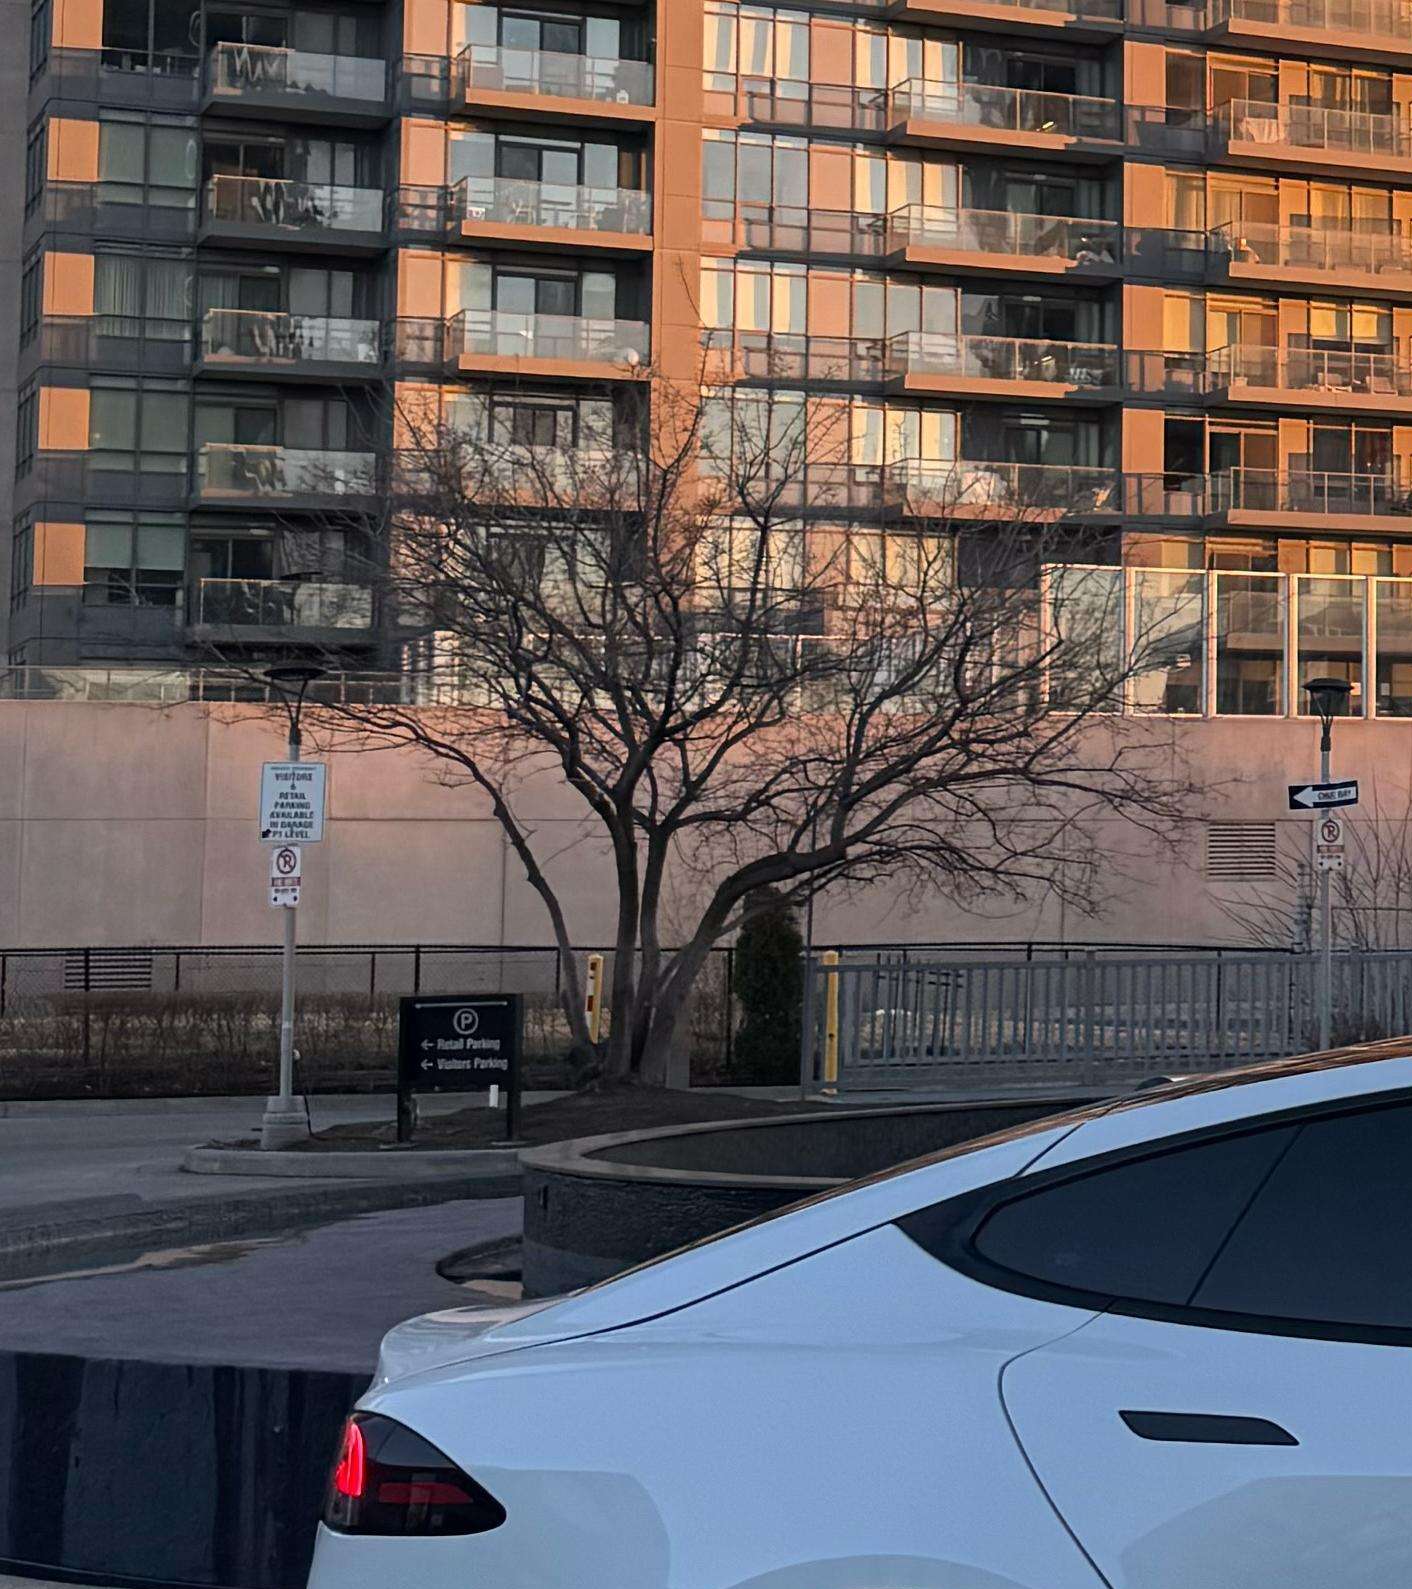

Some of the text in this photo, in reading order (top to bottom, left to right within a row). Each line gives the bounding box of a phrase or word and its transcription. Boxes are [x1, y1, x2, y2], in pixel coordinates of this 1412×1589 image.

[279, 792, 306, 800] RETAIL
[274, 802, 311, 810] PARKING
[270, 811, 314, 819] AVAILABLE
[437, 1038, 500, 1051] Retail Parking
[474, 1057, 508, 1070] Parking
